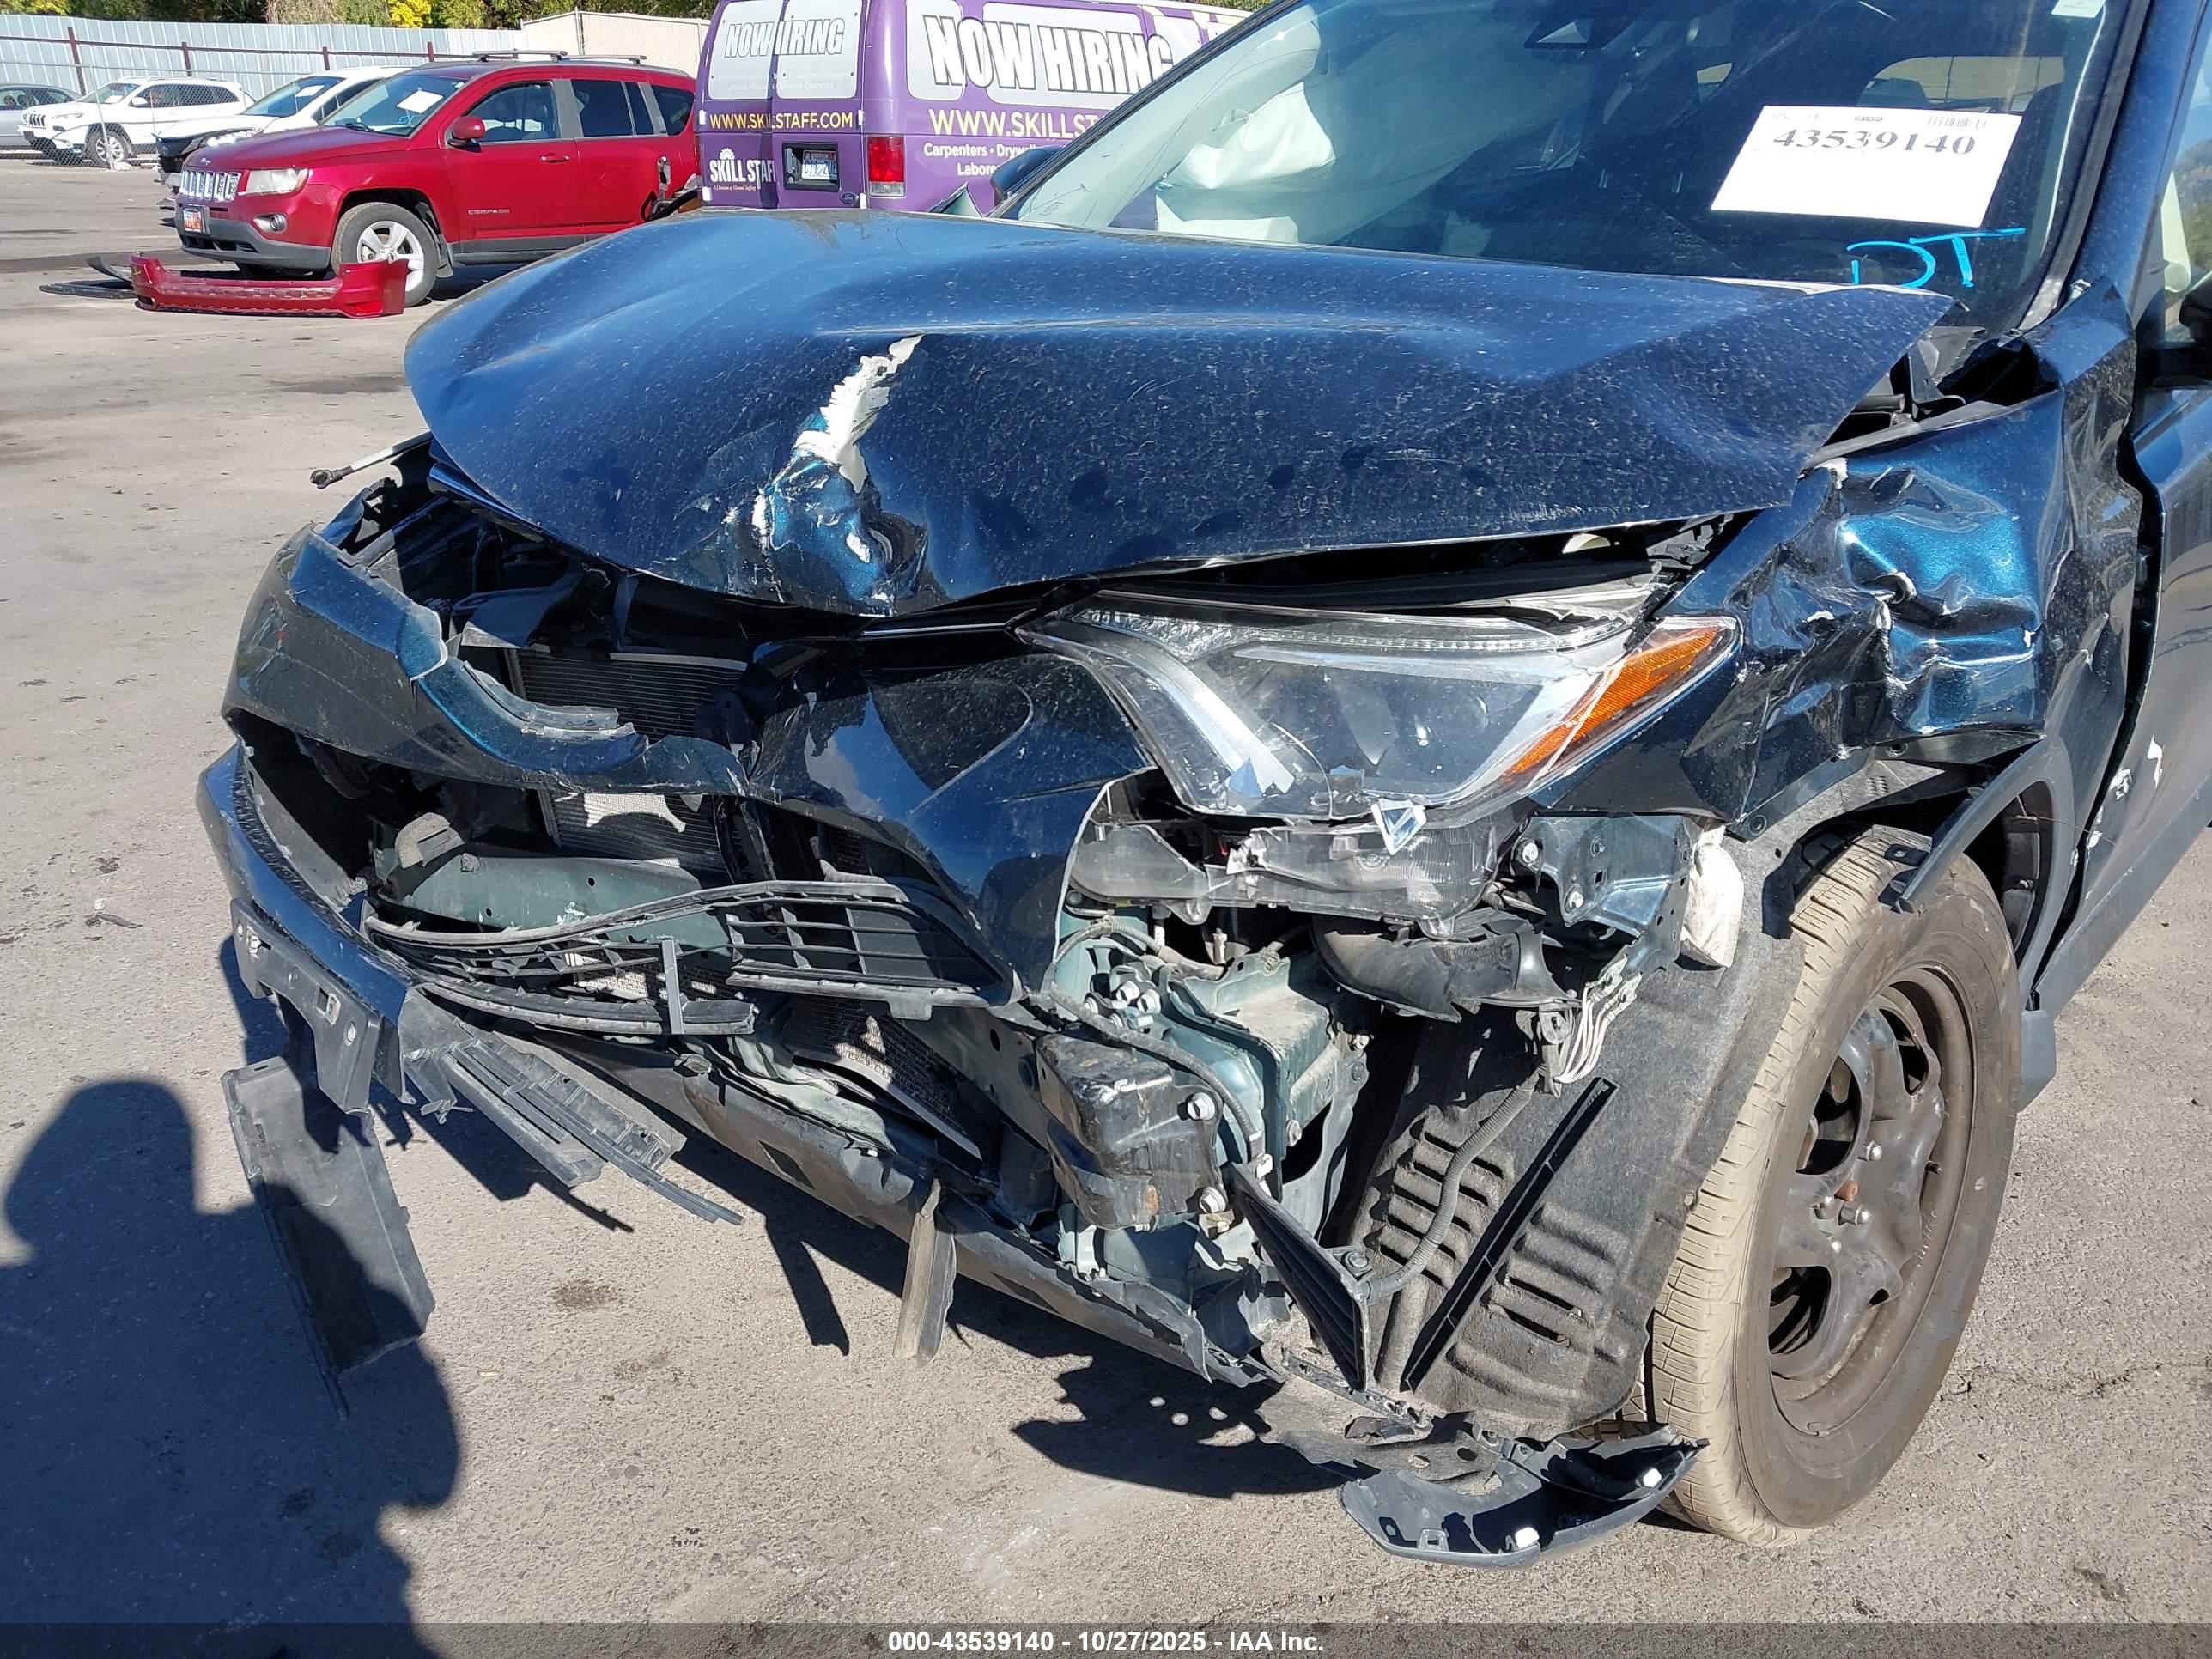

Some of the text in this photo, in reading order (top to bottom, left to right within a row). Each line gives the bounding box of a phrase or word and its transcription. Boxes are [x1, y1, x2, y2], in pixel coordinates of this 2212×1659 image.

[725, 21, 775, 58] NOW
[923, 15, 1174, 94] NOW HIRING
[923, 143, 1036, 160] Carpenters Dryw
[1772, 129, 1977, 155] 43539140
[709, 158, 746, 182] SKILL
[957, 161, 1000, 177] Labore
